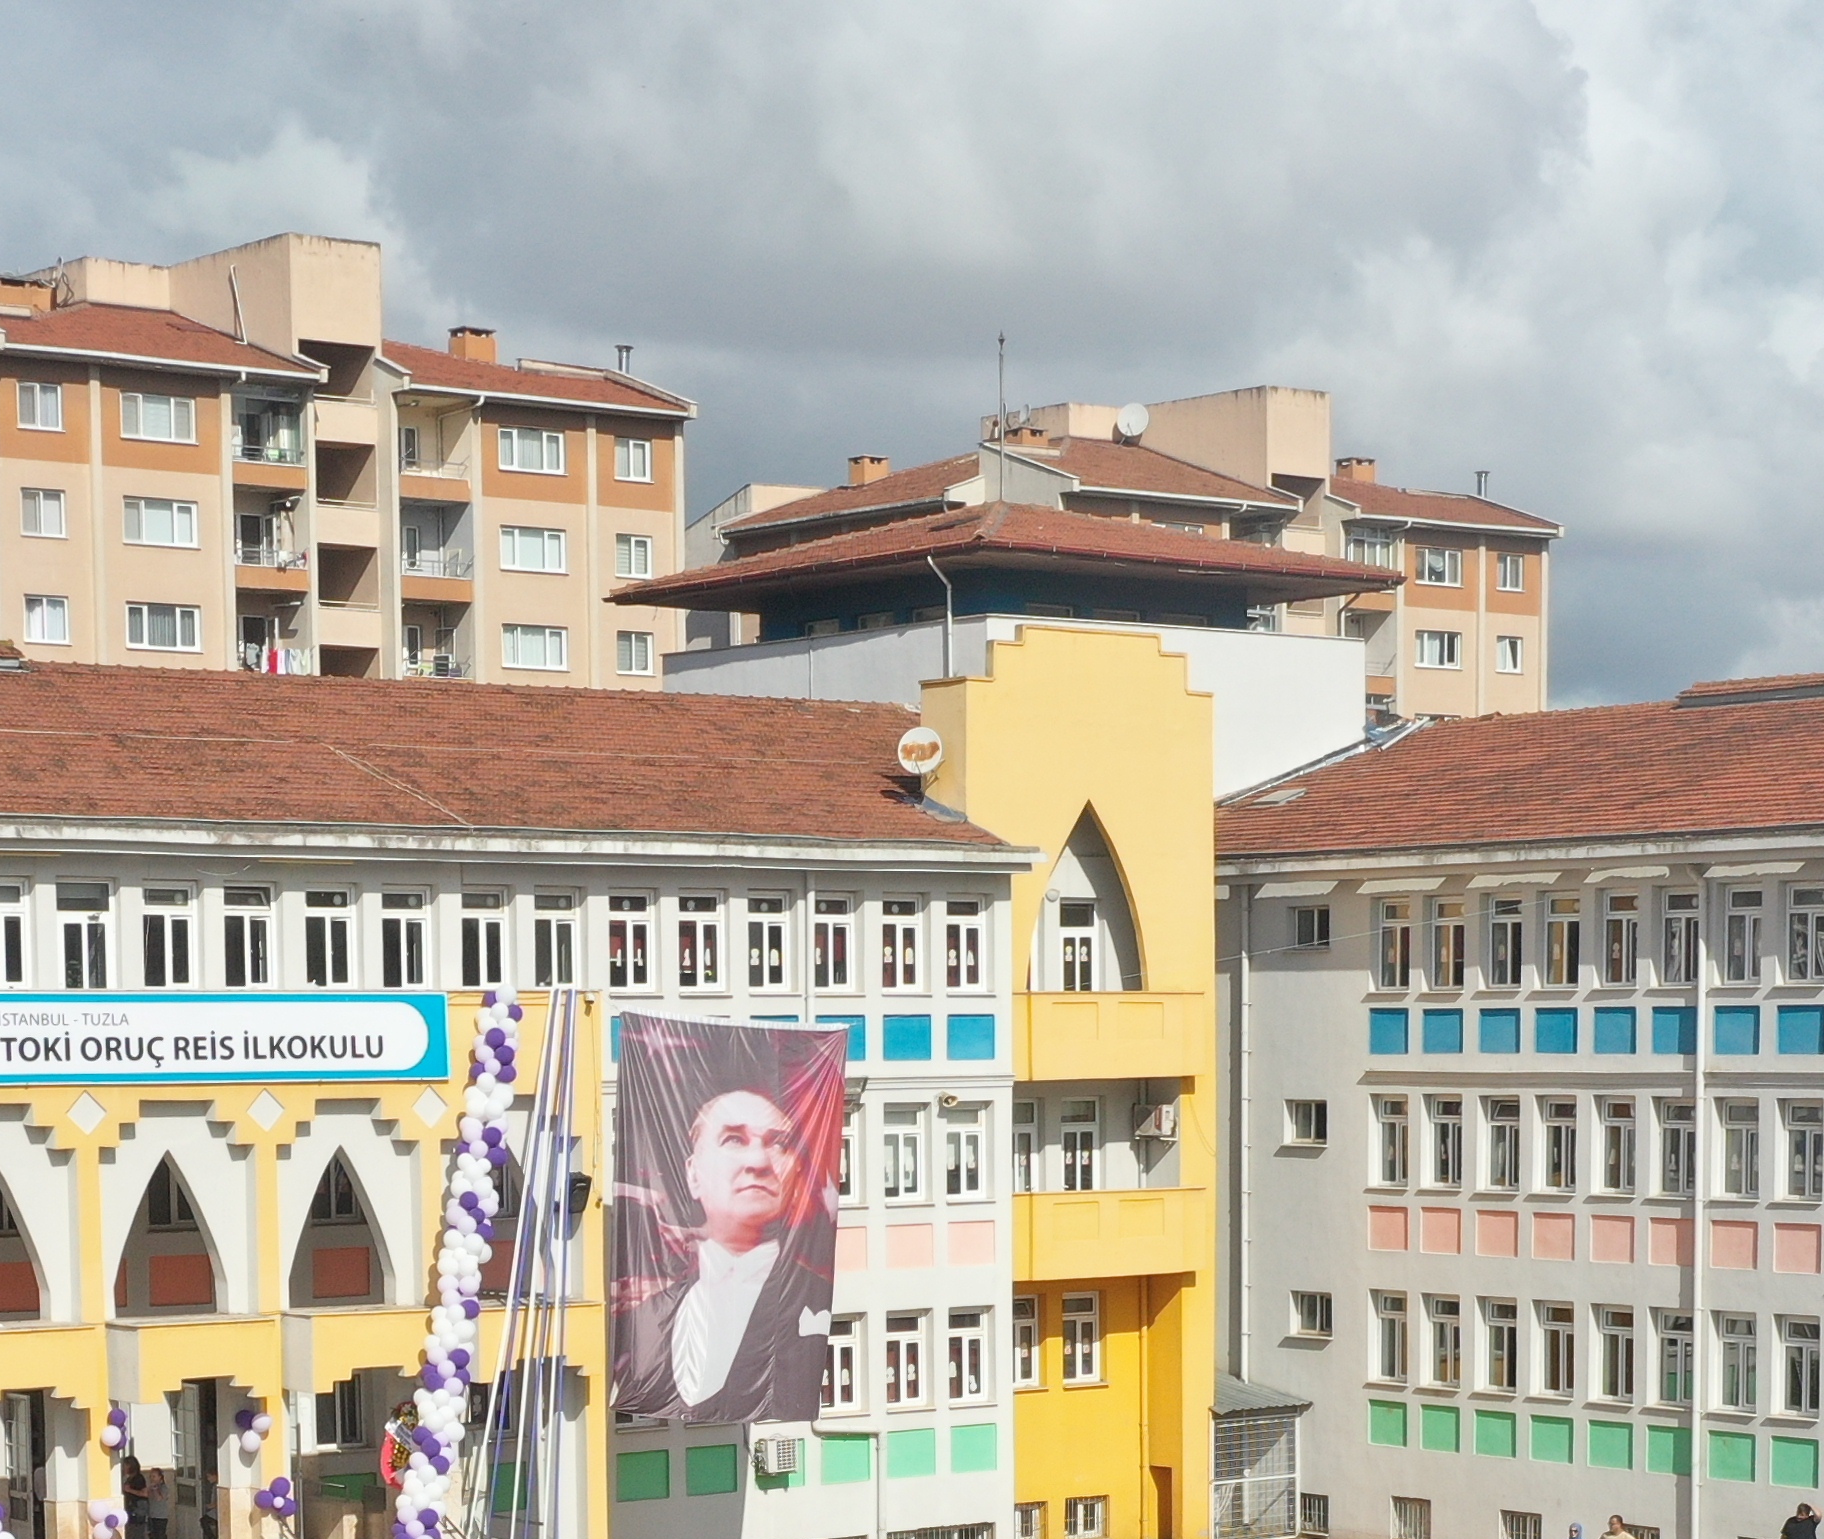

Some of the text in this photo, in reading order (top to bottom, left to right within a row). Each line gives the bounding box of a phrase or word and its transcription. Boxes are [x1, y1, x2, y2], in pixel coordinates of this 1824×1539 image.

[81, 1012, 129, 1027] TUZLA
[0, 1031, 71, 1063] TOKİ
[80, 1036, 165, 1069] ORUÇ
[173, 1031, 235, 1061] REİS
[243, 1030, 384, 1061] İLKOKULU
